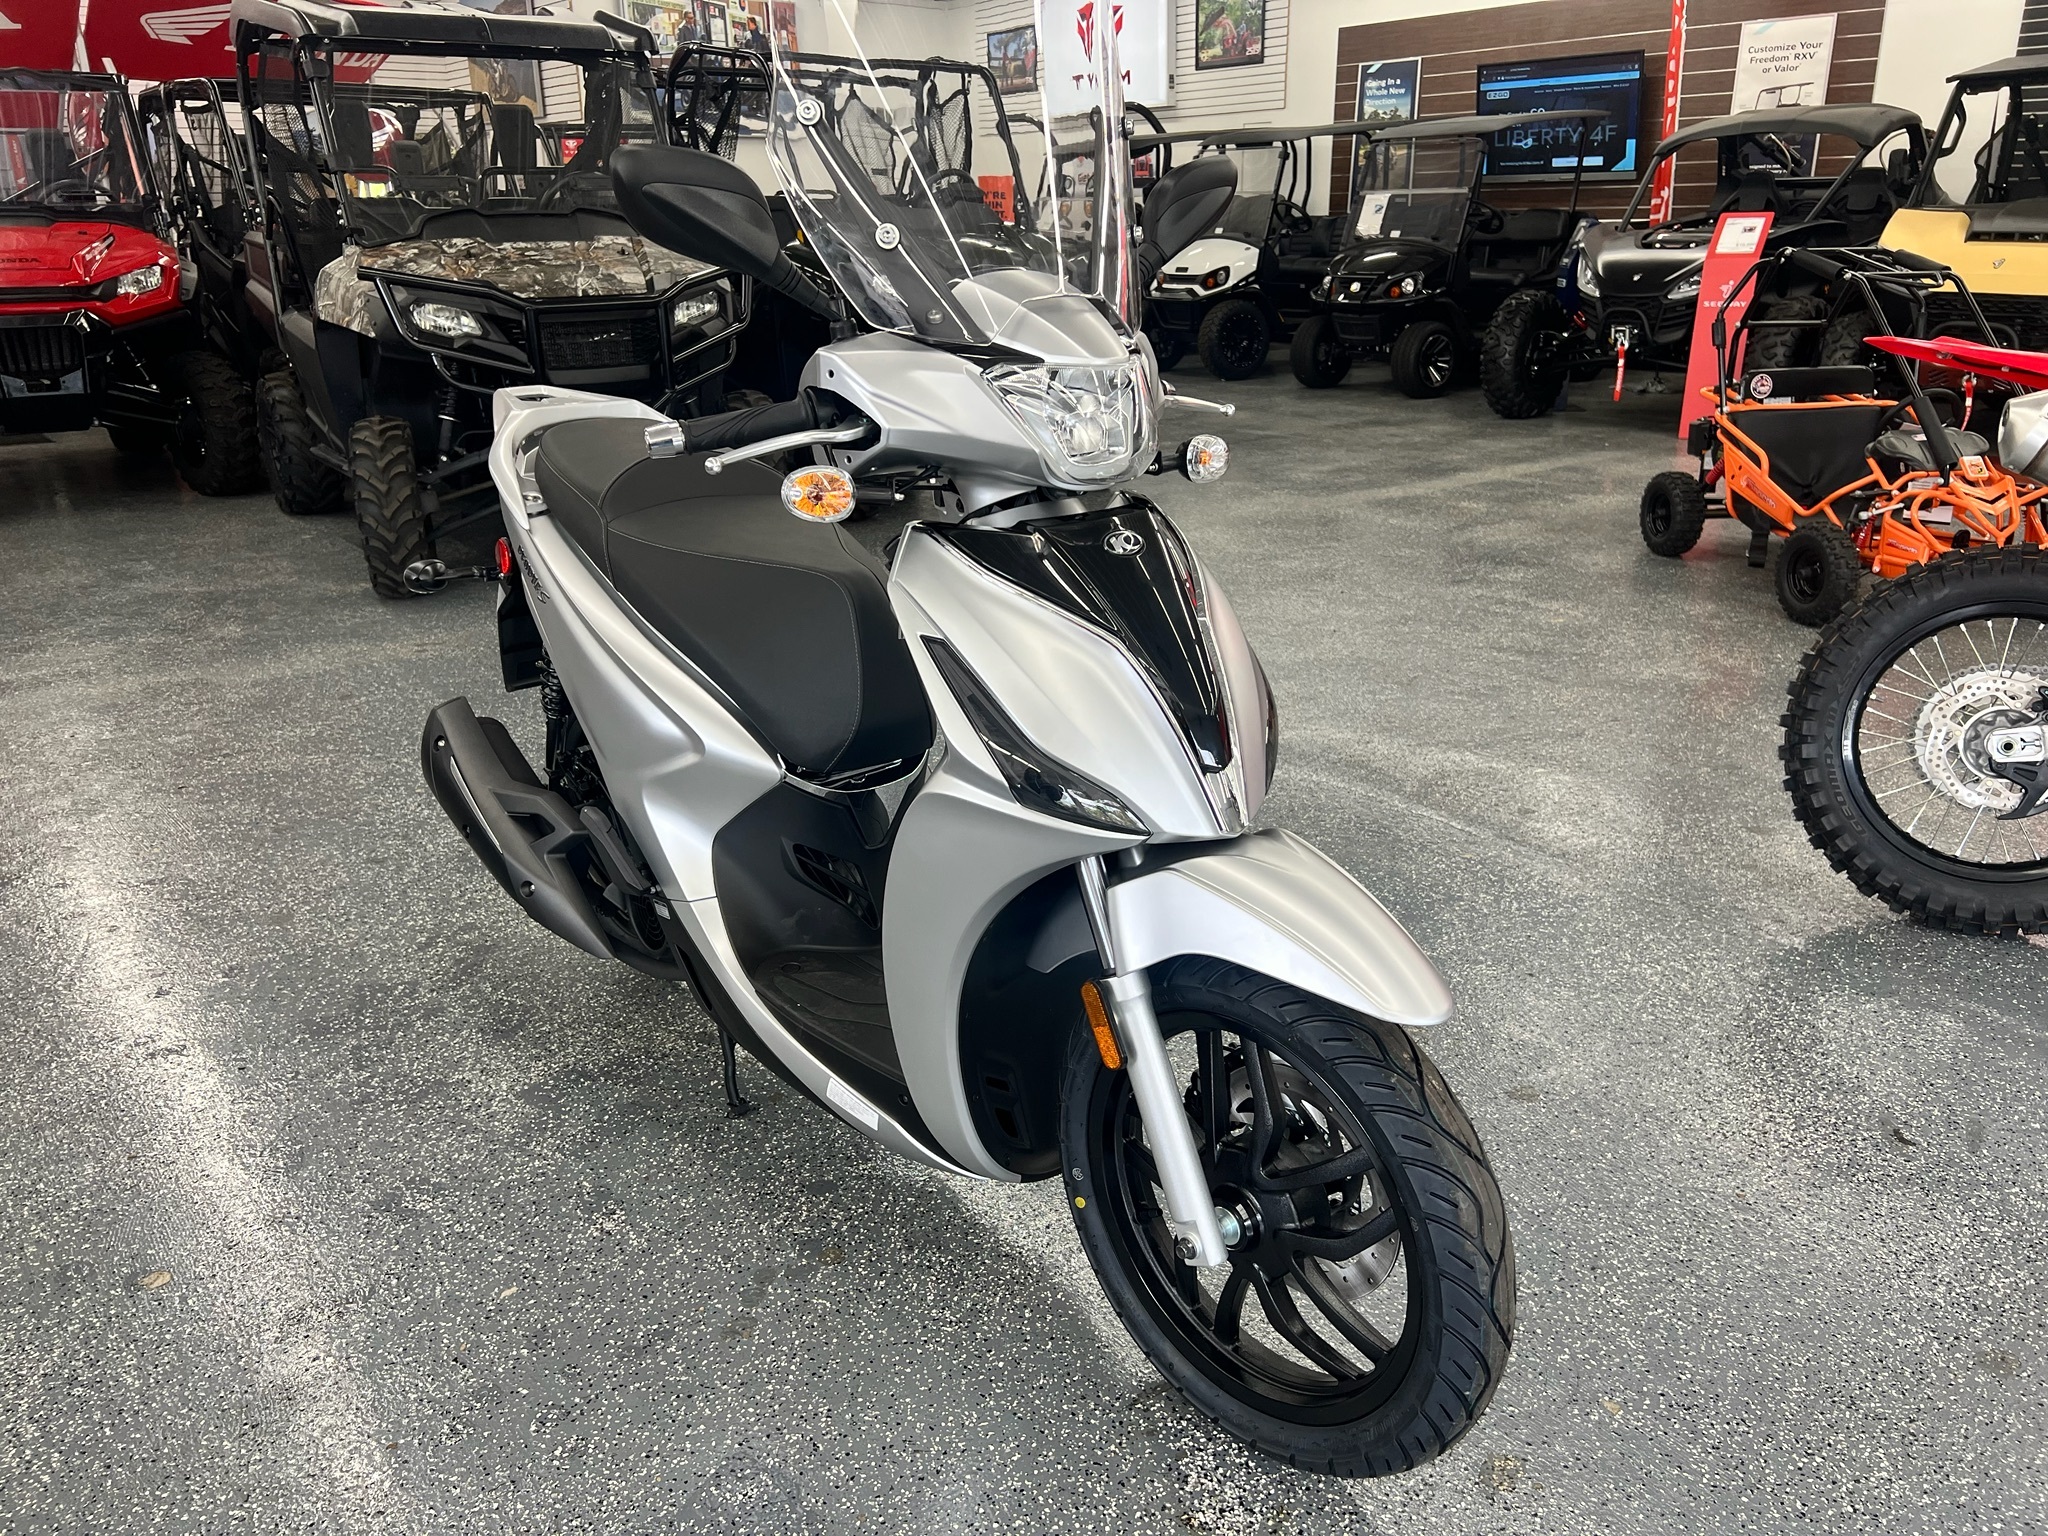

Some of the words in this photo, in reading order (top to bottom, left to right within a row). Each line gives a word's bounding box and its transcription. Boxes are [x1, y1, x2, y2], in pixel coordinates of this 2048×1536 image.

[1748, 44, 1797, 54] Customize
[1800, 41, 1823, 50] Your
[1794, 51, 1816, 61] RXV
[1366, 79, 1386, 87] Going
[1365, 88, 1388, 97] Whole
[1389, 87, 1406, 95] New
[1365, 98, 1397, 106] Direction
[1494, 126, 1585, 147] LIBERTY
[1589, 124, 1618, 143] 4F
[1824, 732, 1868, 837] GEOMAX
